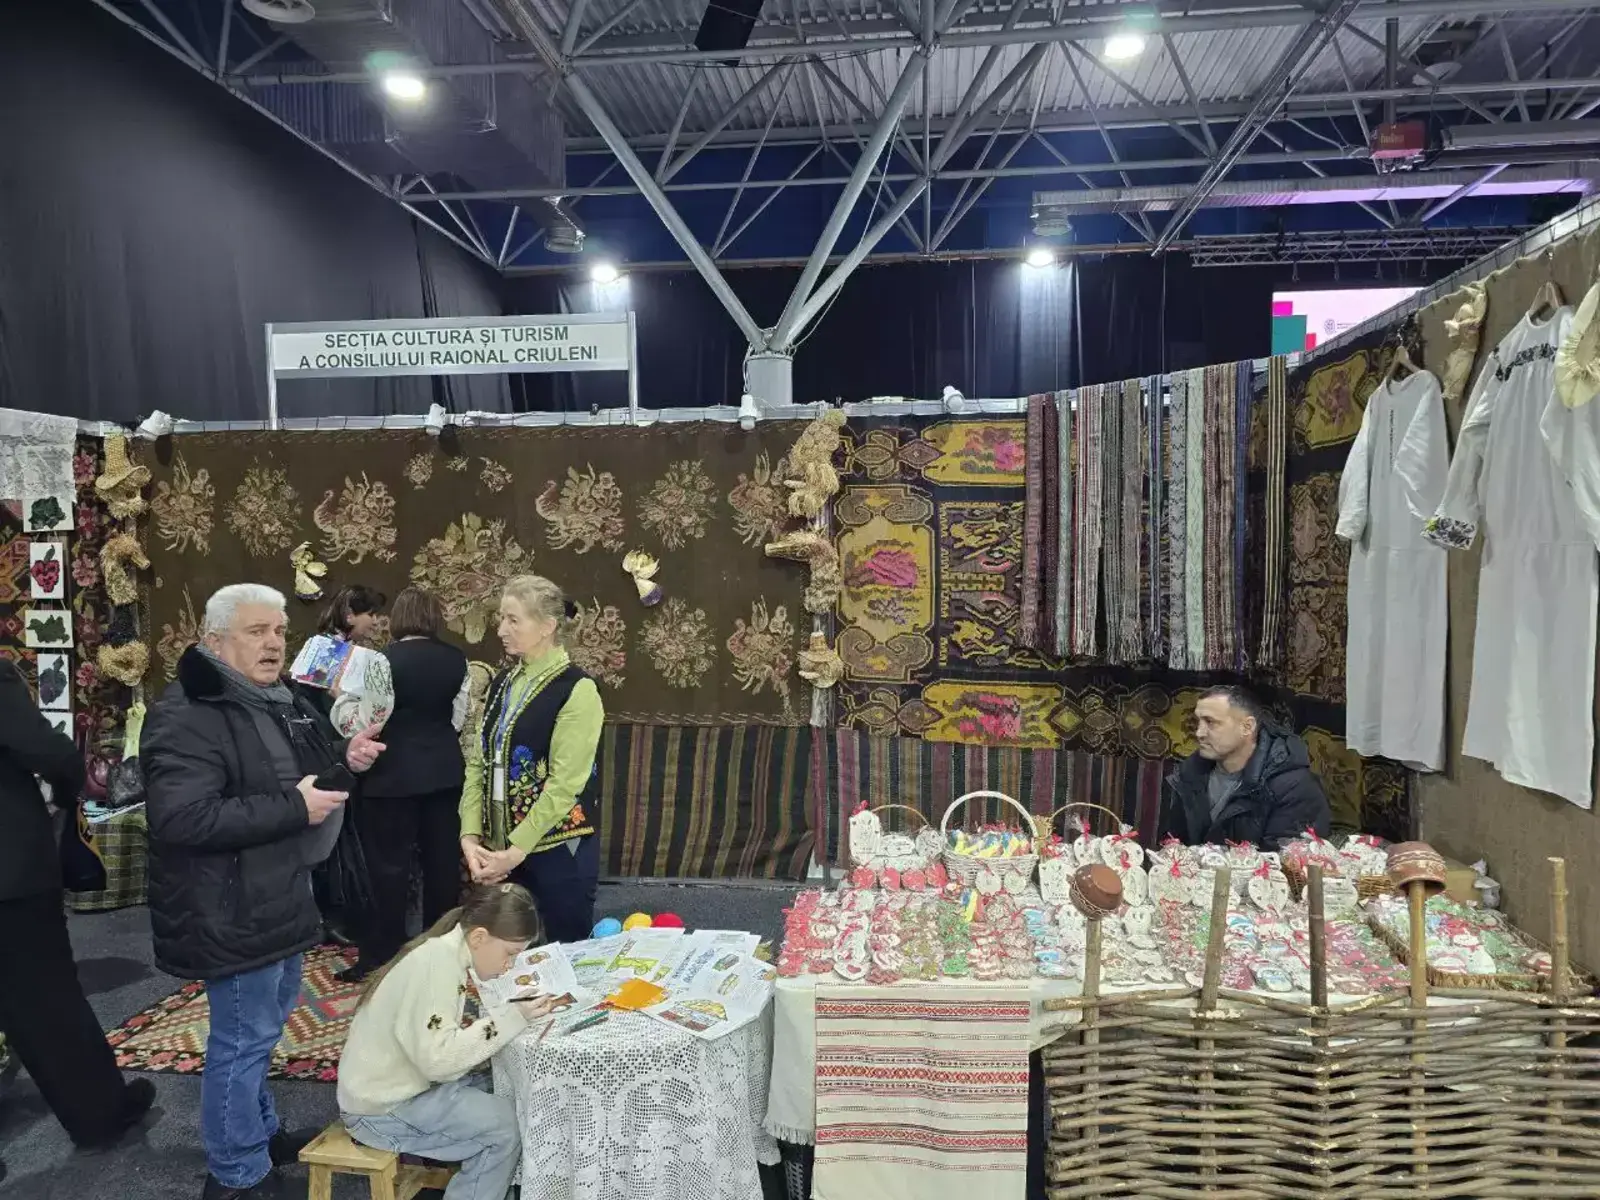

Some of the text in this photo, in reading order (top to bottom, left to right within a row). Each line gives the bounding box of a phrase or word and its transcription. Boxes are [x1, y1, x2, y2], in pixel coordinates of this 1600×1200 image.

[325, 332, 388, 351] SECȚIA
[480, 329, 496, 348] ȘI
[501, 326, 569, 342] TURISM
[299, 345, 598, 369] A CONSILIULUI RAIONAL CRIULENI
